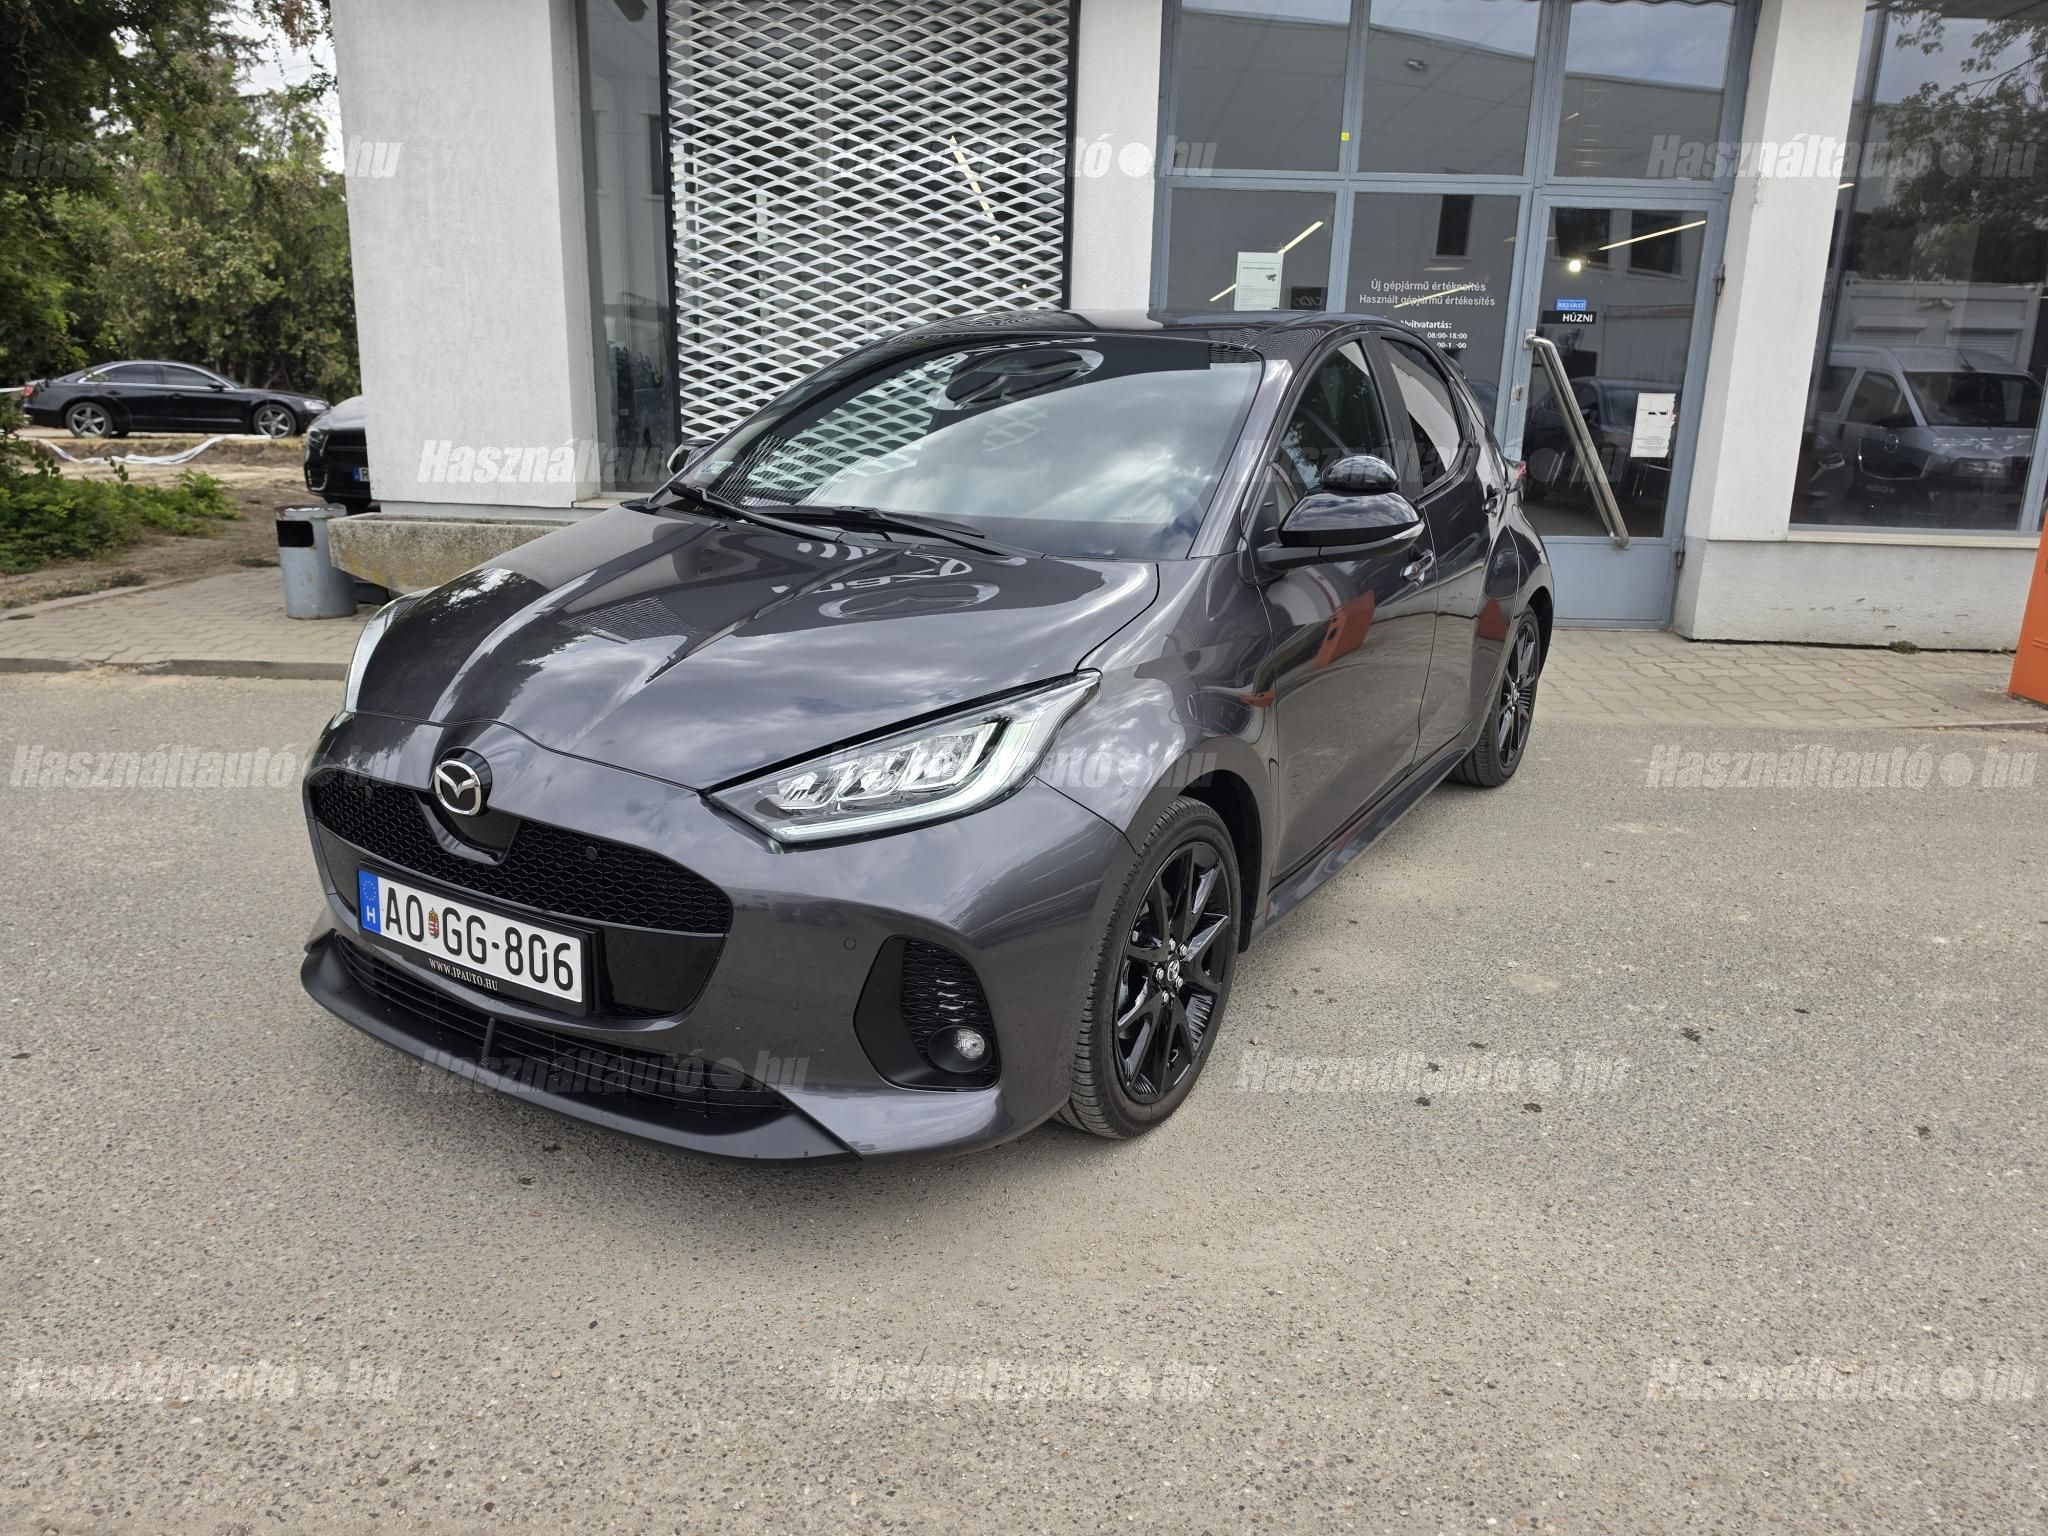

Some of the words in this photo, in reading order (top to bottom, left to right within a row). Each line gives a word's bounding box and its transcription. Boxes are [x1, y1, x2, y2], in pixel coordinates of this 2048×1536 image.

[1371, 279, 1380, 291] Új
[1384, 280, 1429, 291] gépjármű
[1359, 295, 1398, 304] Használt
[1445, 297, 1495, 306] értékesítés
[1562, 312, 1593, 323] HÚZNI
[366, 905, 376, 924] H
[385, 887, 424, 942] AO
[442, 907, 573, 991] GG-806
[429, 958, 498, 992] WWW.JPAUTO.HU
